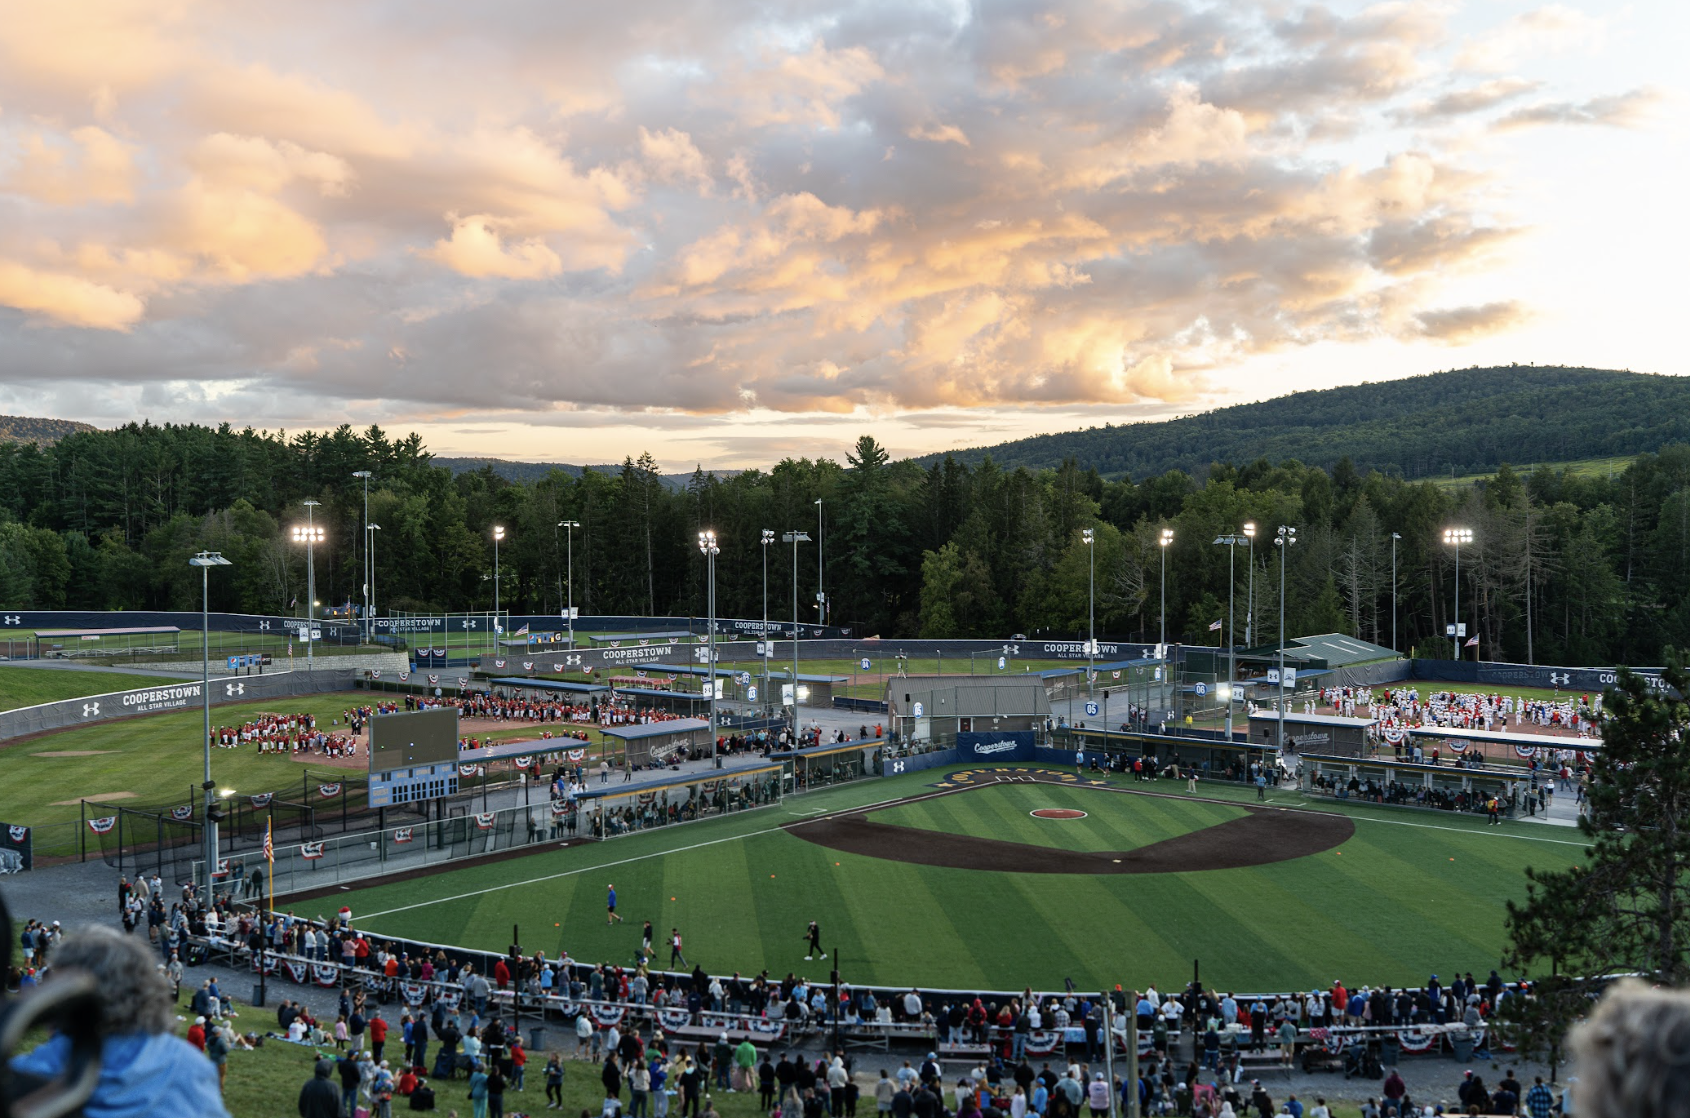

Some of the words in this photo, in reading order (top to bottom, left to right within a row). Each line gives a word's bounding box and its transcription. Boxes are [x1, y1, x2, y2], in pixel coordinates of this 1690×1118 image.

[378, 619, 441, 627] COOPERSTOWN
[735, 622, 782, 630] COOPERSOWN
[602, 646, 672, 660] COOPERSTOWN
[1044, 644, 1118, 654] COOPERSOWN
[1196, 686, 1205, 694] 06
[123, 686, 200, 706] COOPERSTOWN
[164, 699, 186, 707] VILLAGE
[1086, 704, 1096, 714] 05
